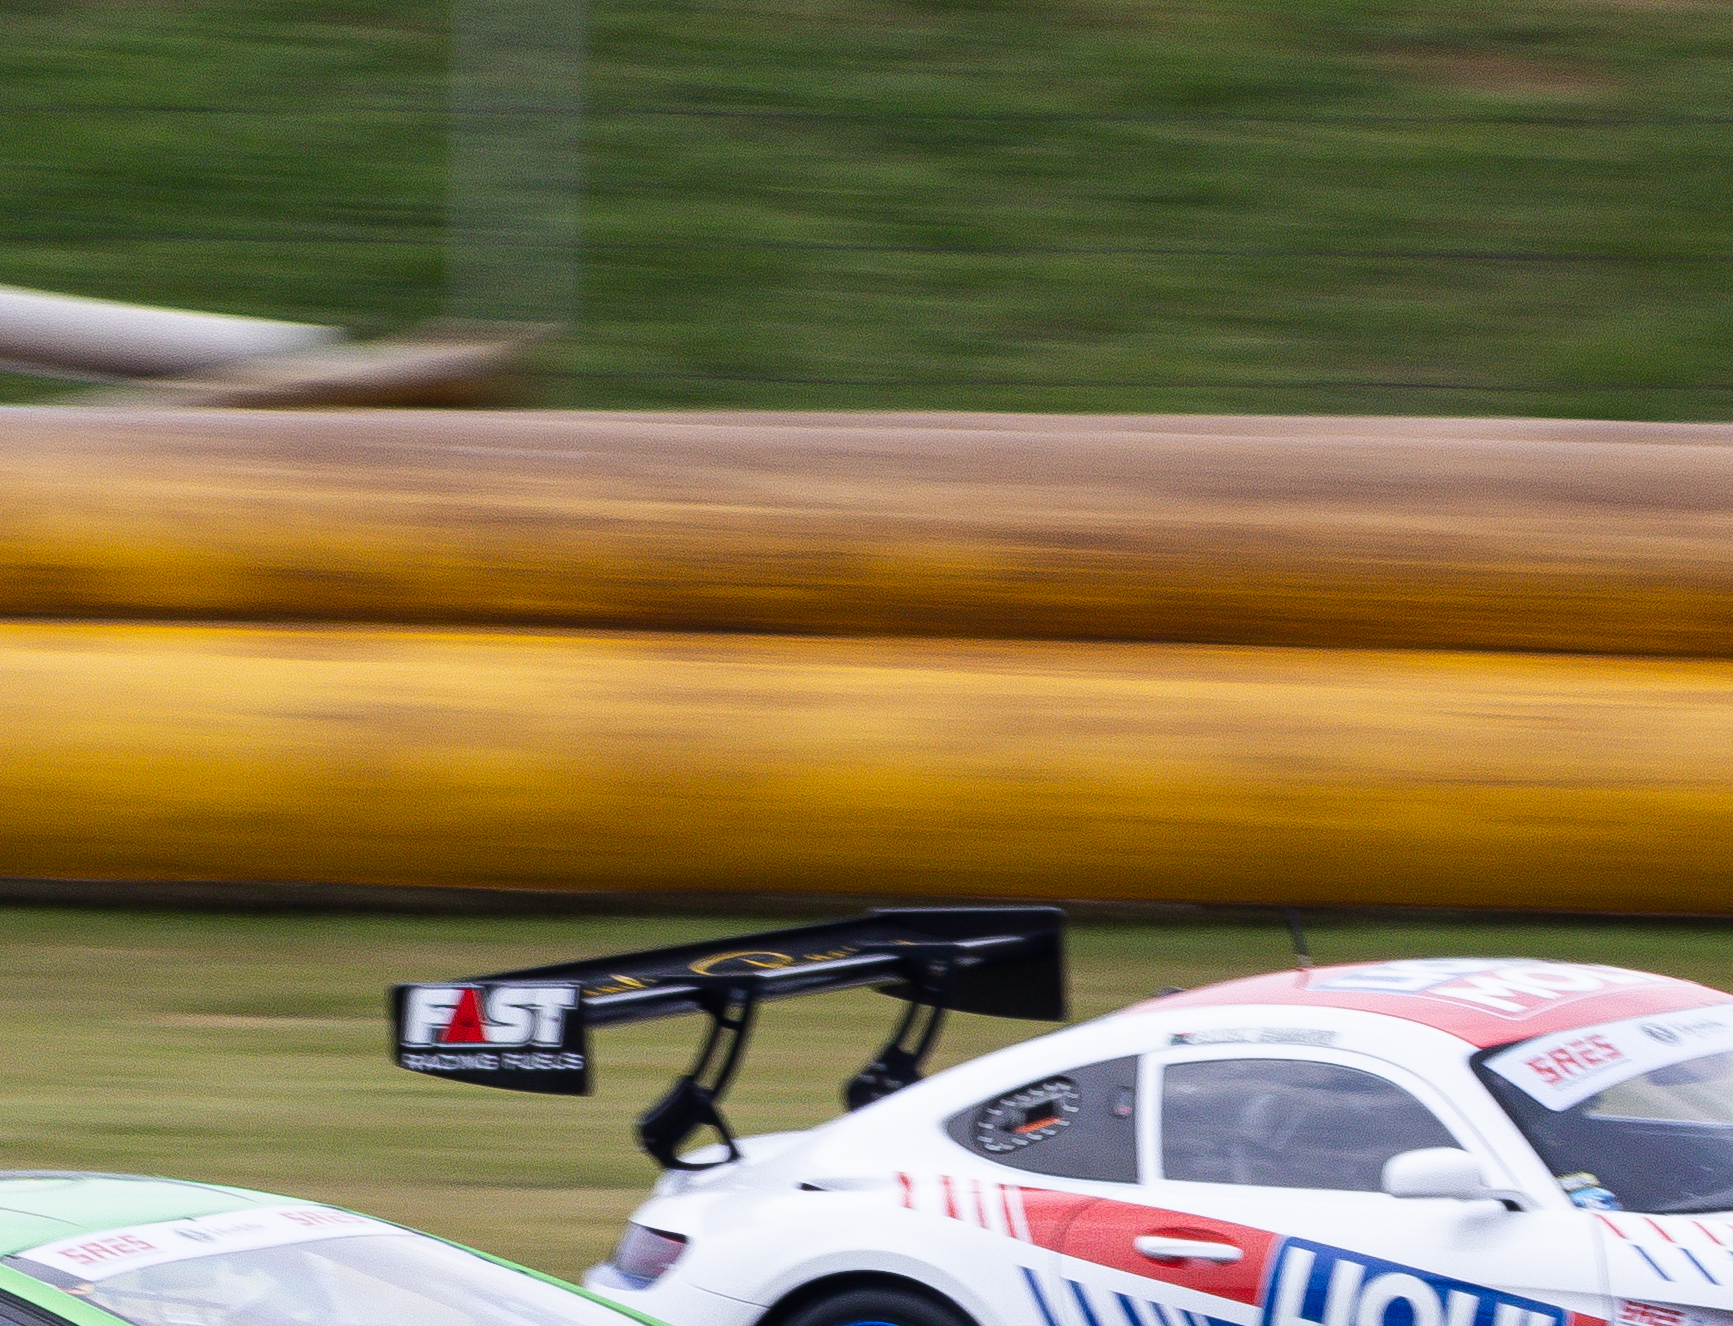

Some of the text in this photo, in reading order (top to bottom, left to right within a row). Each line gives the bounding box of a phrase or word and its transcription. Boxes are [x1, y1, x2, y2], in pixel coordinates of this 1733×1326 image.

[400, 983, 581, 1047] FAST
[400, 1052, 585, 1071] RACING FUELS
